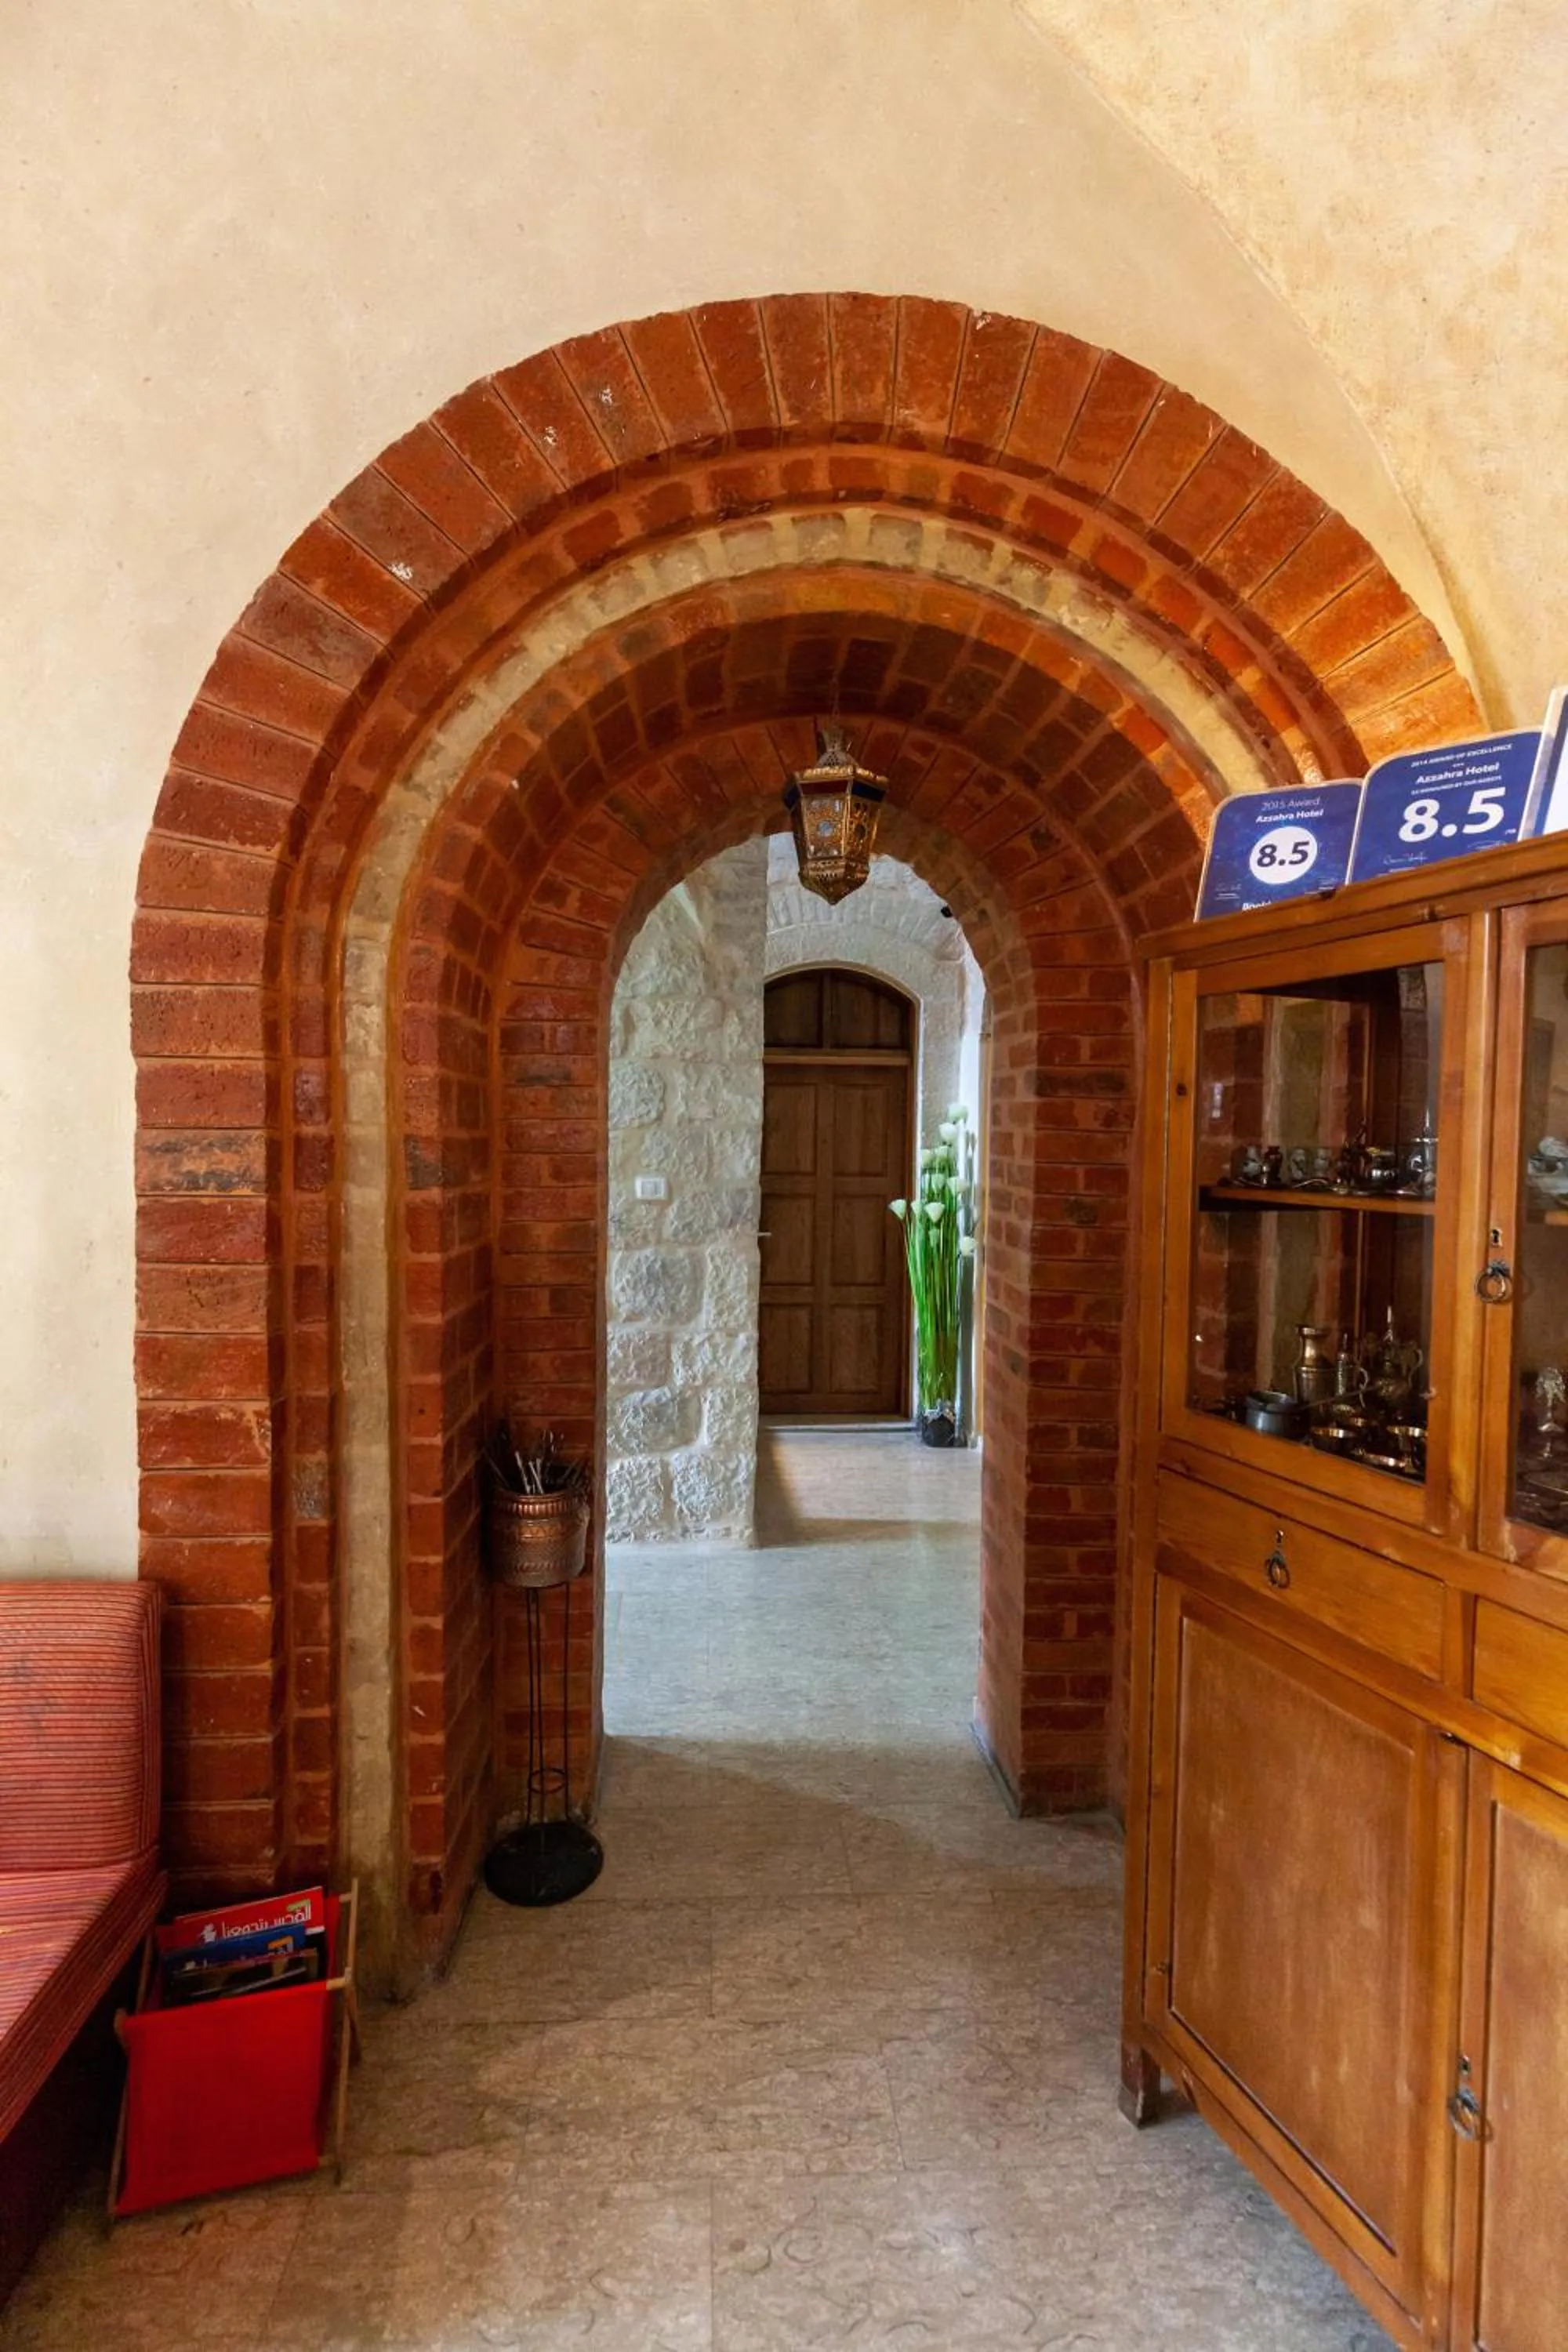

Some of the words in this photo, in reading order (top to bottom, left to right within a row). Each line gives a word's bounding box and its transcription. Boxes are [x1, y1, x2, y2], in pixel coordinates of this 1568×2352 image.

[1465, 761, 1500, 775] Hotel
[1287, 797, 1320, 808] Award
[1296, 808, 1324, 818] Hotel
[1399, 787, 1506, 843] 8.5
[1257, 840, 1310, 868] 8.5
